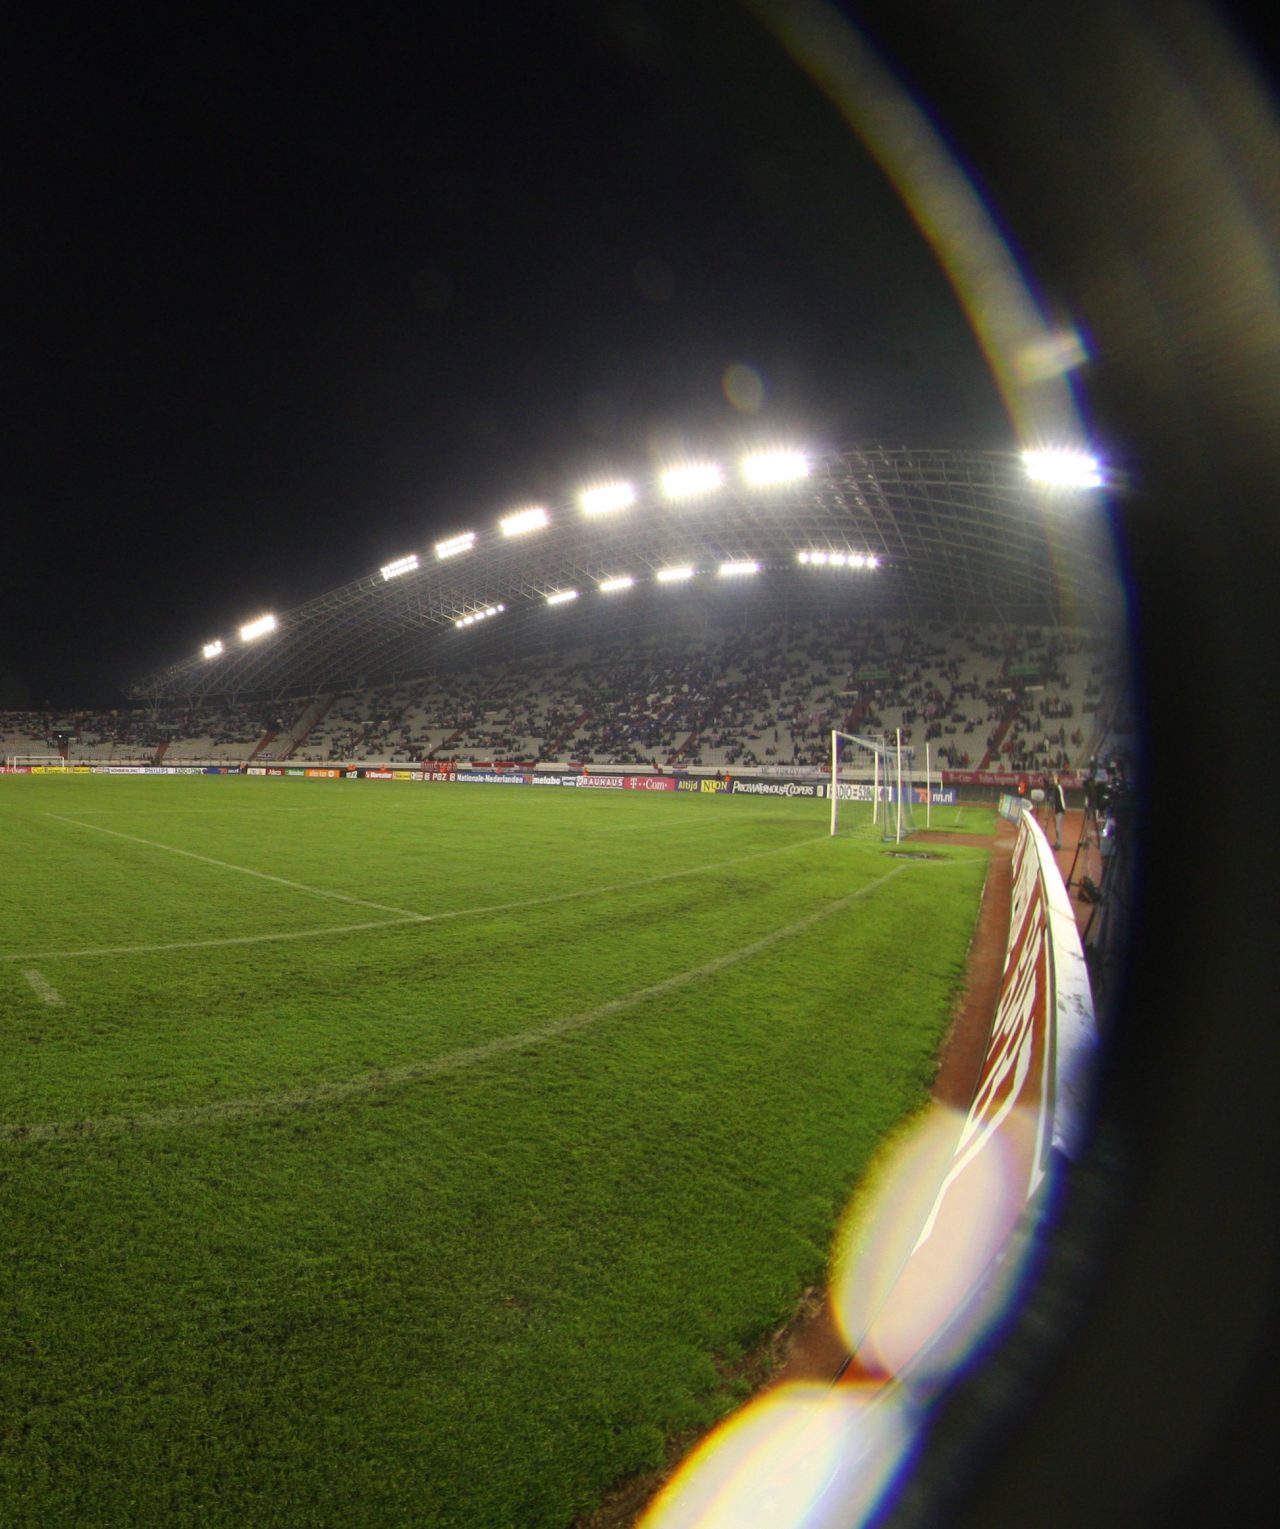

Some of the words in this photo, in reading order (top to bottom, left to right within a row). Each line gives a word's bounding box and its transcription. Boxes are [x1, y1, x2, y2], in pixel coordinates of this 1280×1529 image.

[532, 775, 561, 785] metabo
[583, 777, 623, 788] BAUHAUS
[678, 781, 698, 790] Altijd
[933, 791, 952, 802] nn.nl
